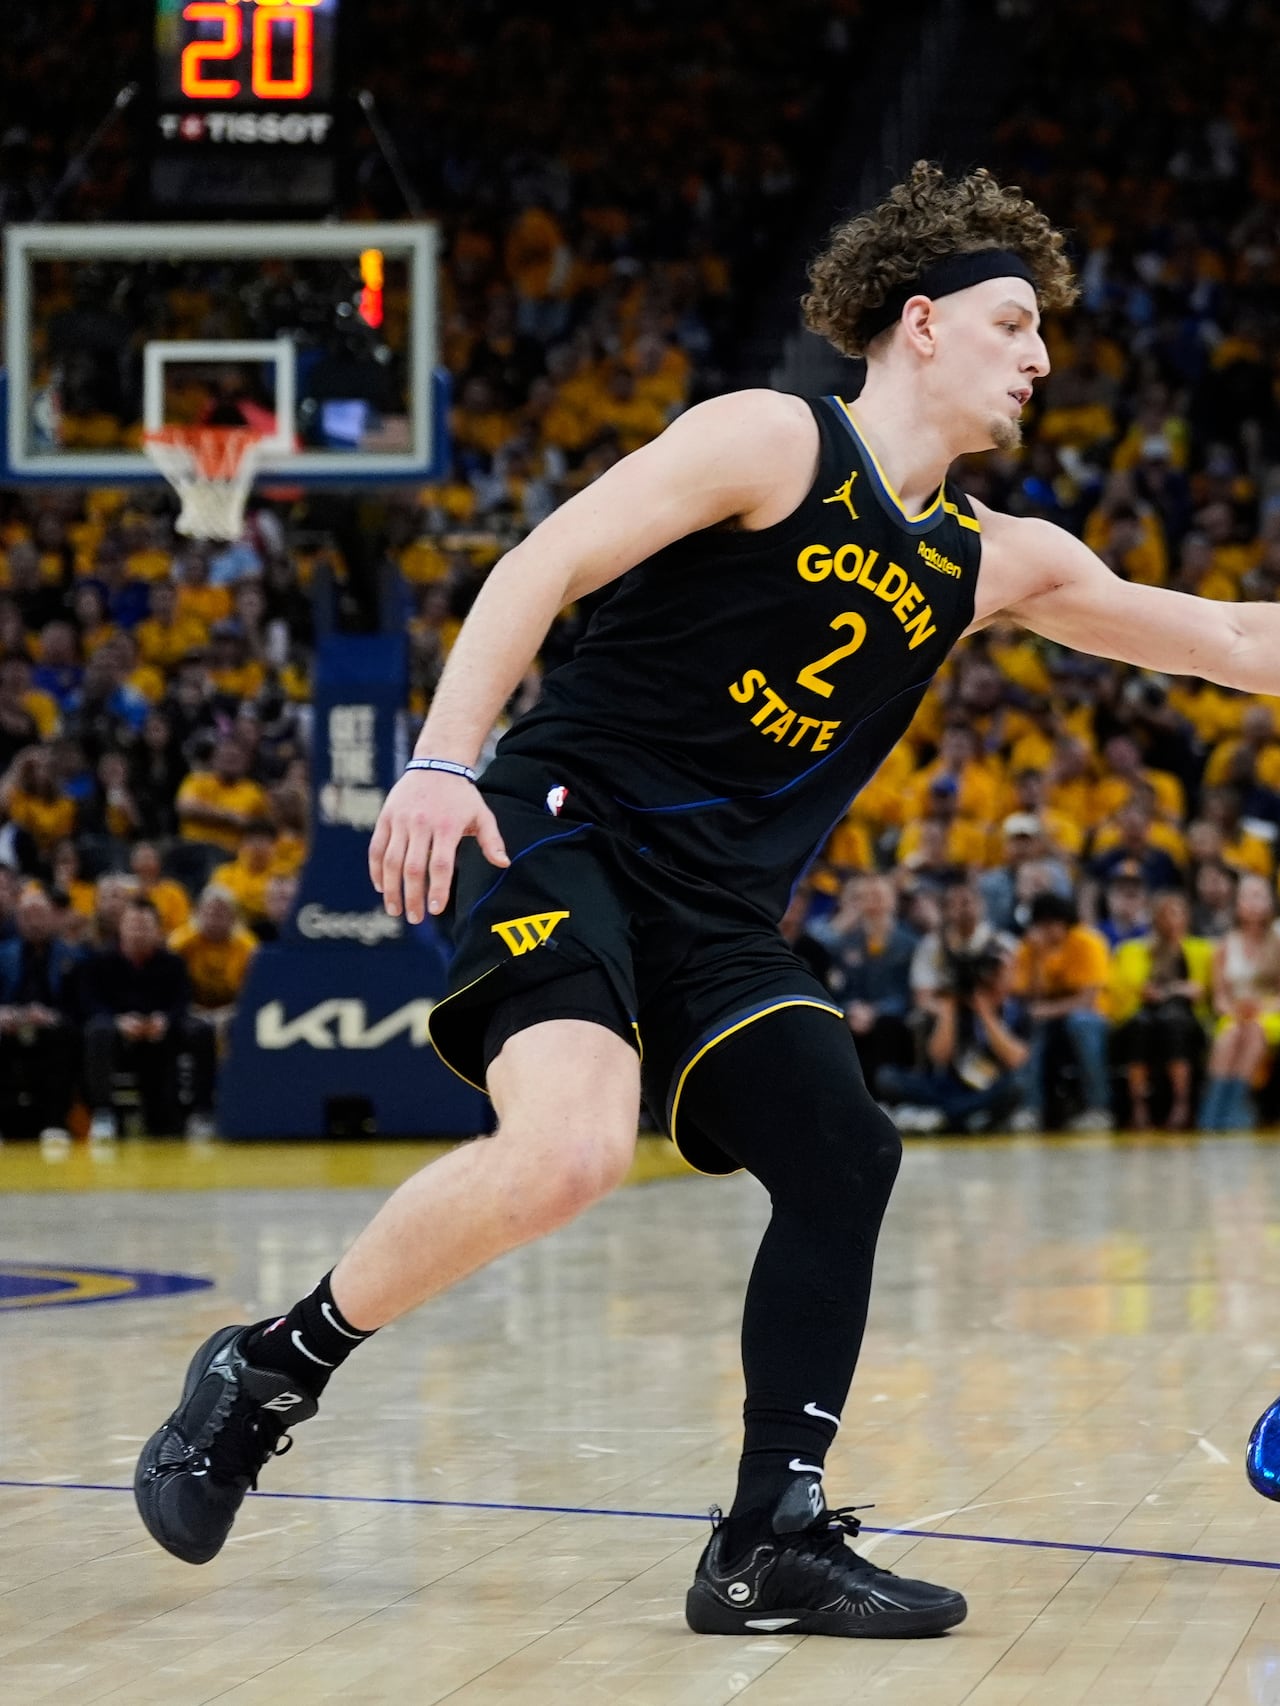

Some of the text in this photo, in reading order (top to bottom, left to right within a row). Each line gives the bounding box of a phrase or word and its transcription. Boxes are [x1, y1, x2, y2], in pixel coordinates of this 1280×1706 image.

[181, 2, 314, 99] 20
[204, 111, 333, 144] TISSOT
[797, 543, 937, 650] GOLDEN
[917, 540, 962, 579] Rakuten
[796, 611, 867, 699] 2
[728, 669, 842, 752] STATE
[297, 903, 402, 946] Google
